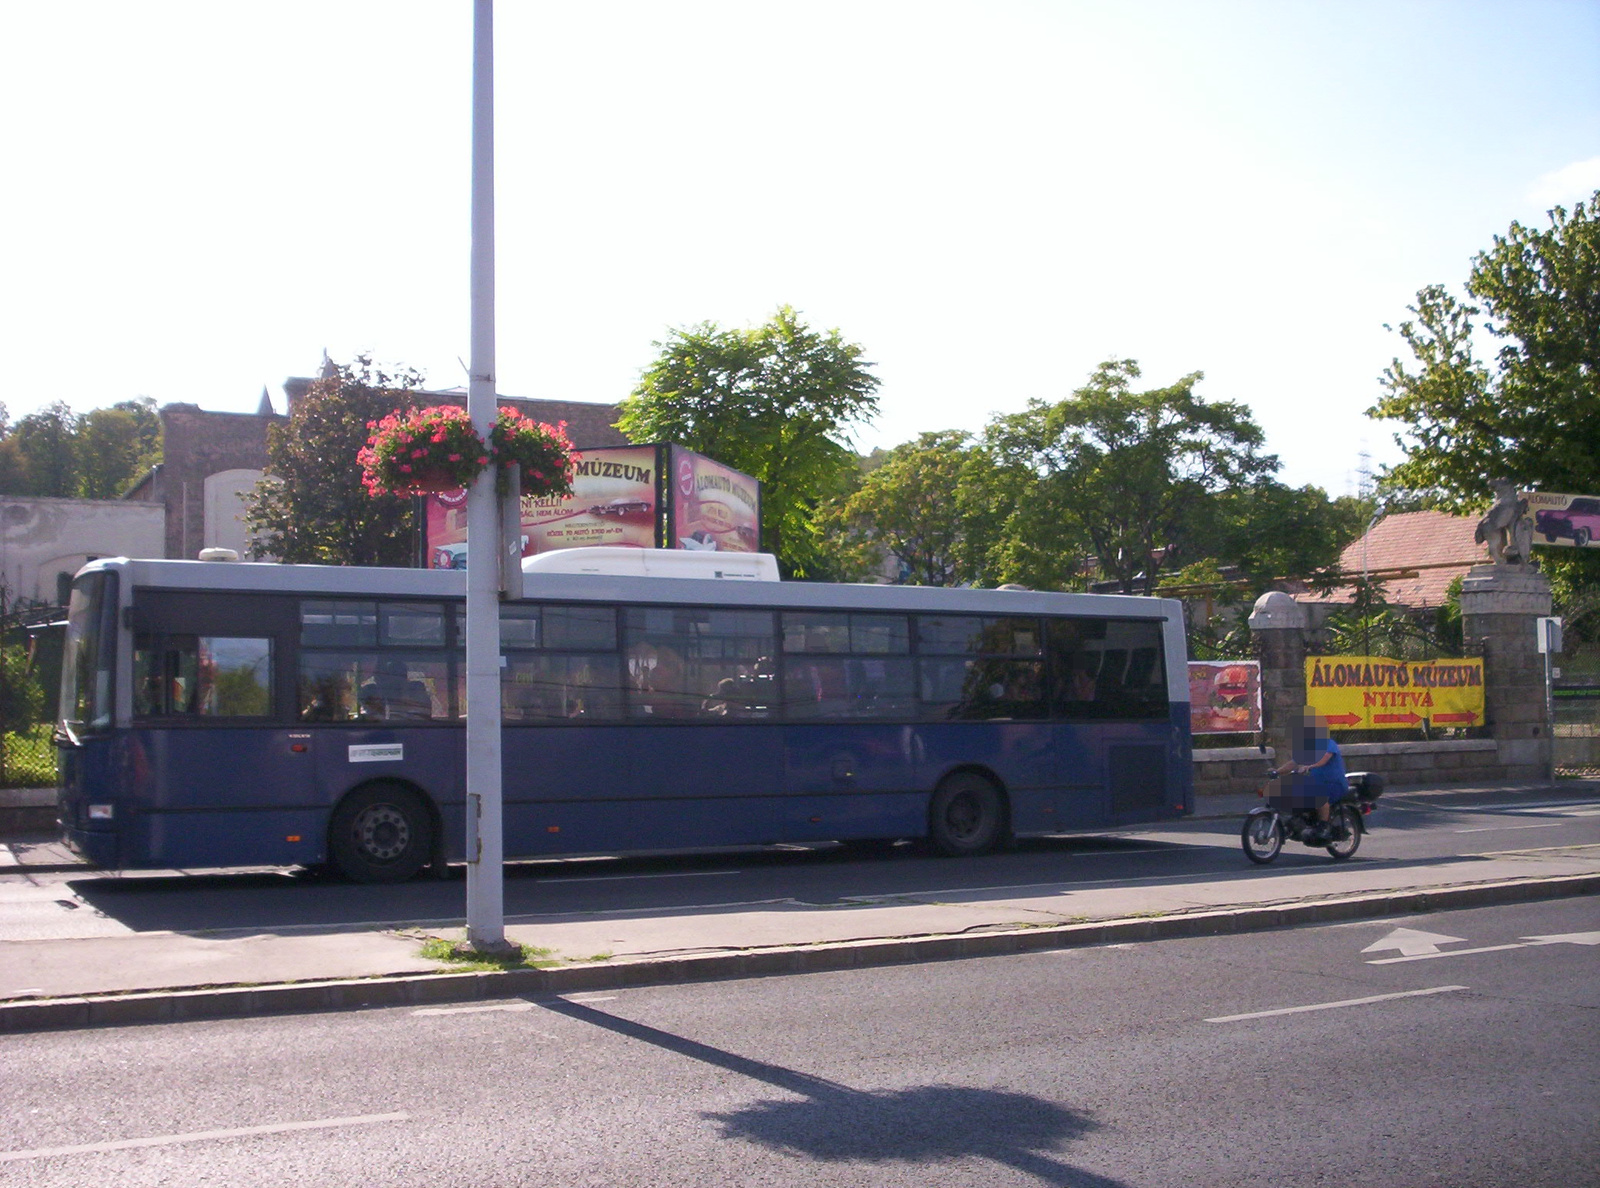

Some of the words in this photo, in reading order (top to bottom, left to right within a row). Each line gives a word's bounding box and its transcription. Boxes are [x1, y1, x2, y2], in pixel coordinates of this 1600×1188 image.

[576, 457, 651, 484] MÚZEUM
[521, 498, 532, 509] NI
[1310, 659, 1410, 688] ÁLOMAUTÓ
[1412, 660, 1483, 688] MÚZEUM
[1362, 691, 1434, 708] NYITVA
